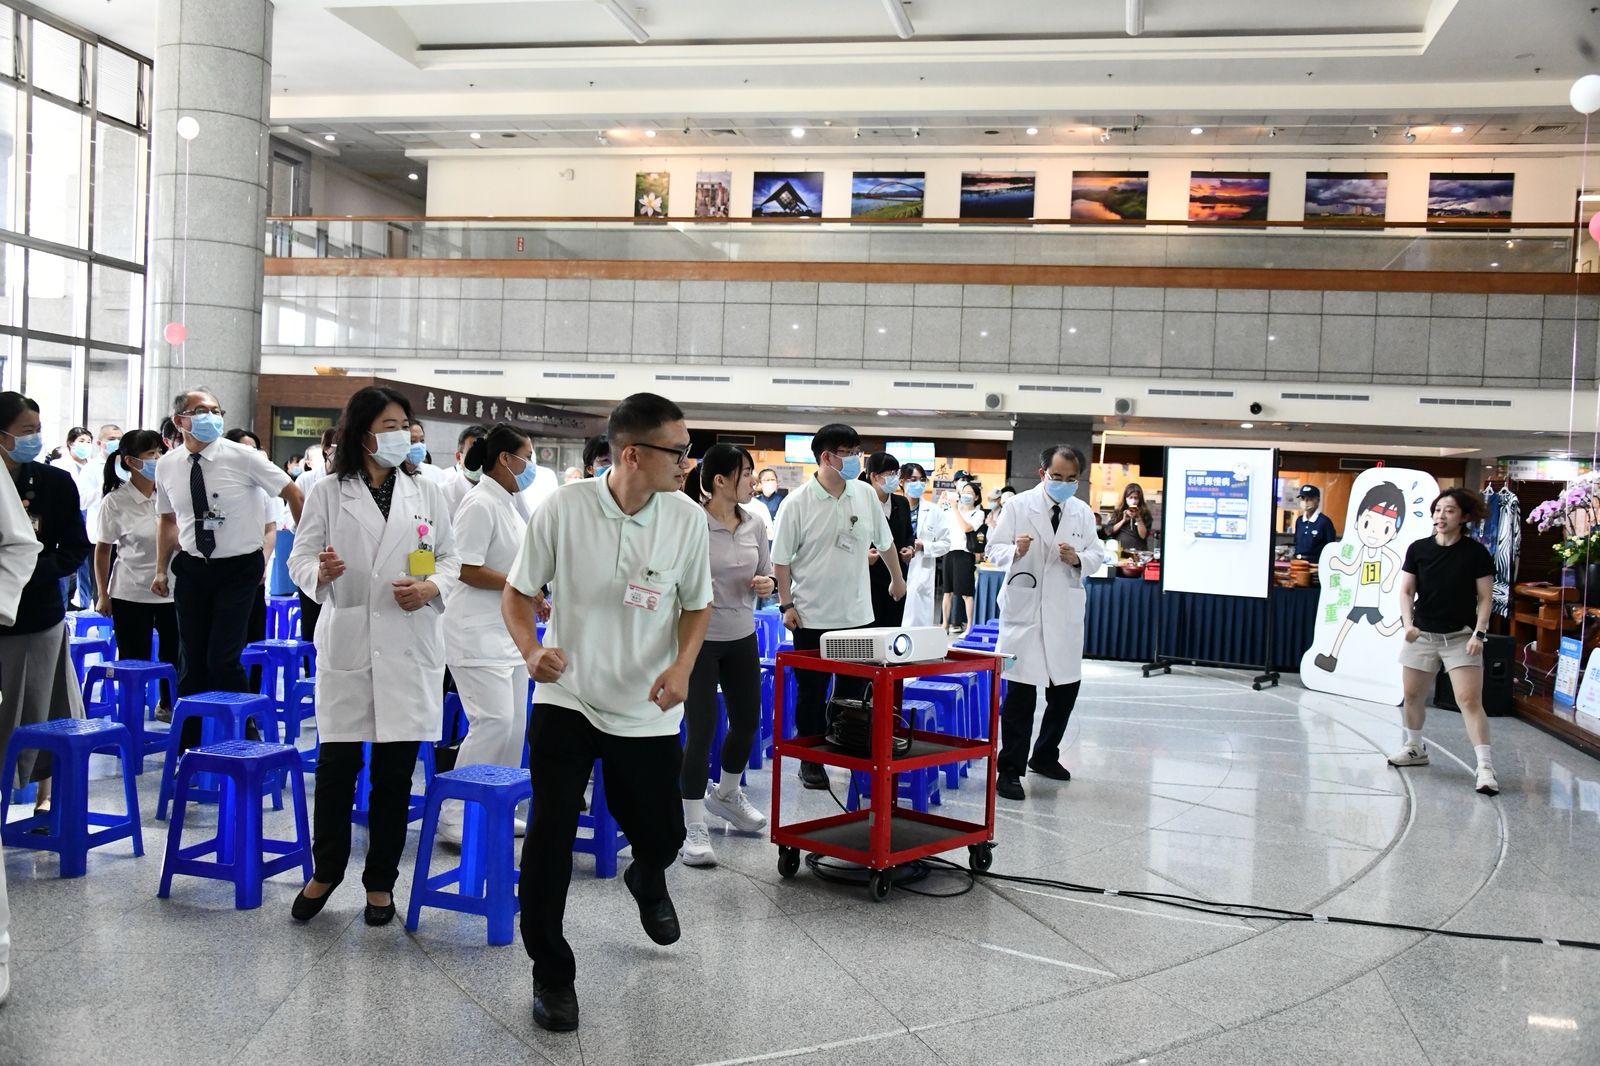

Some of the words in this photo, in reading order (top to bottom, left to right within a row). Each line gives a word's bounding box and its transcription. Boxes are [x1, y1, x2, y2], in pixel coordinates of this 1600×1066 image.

[426, 391, 513, 422] 住院服務中心
[1366, 564, 1376, 582] 13
